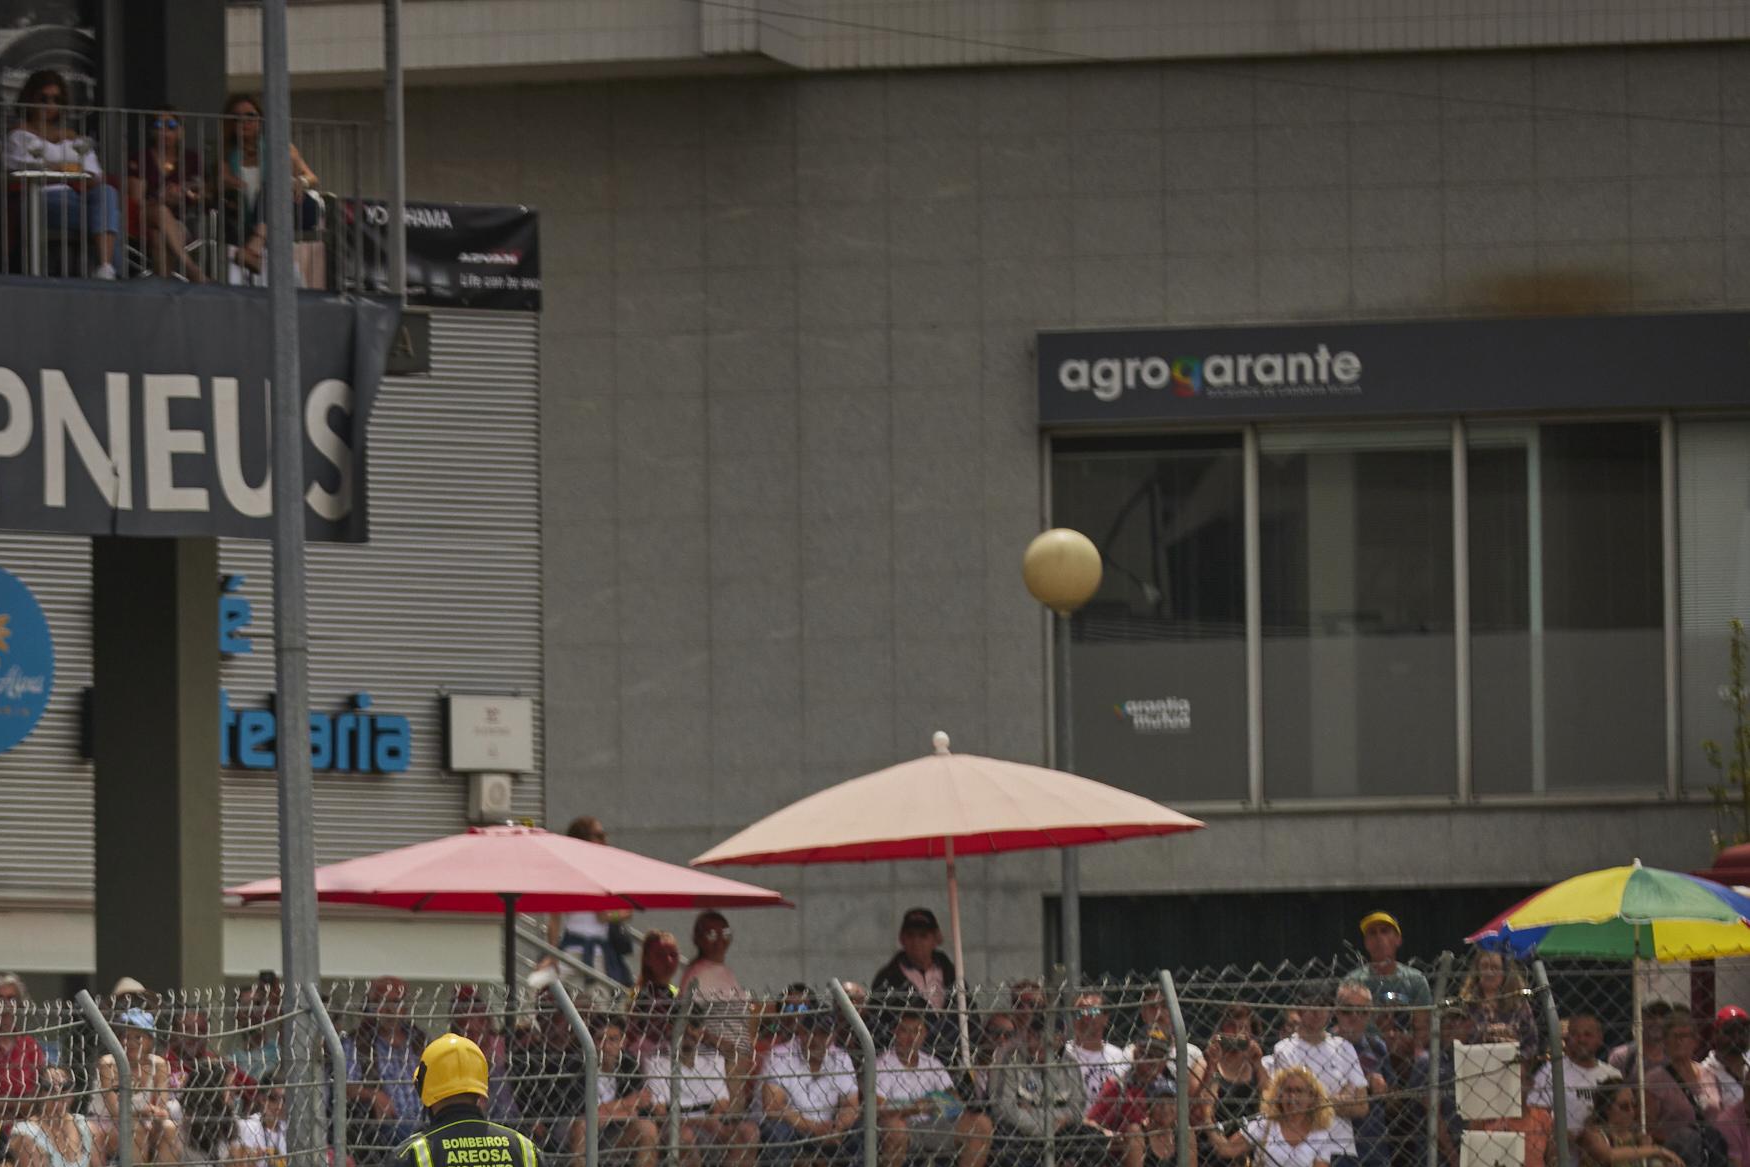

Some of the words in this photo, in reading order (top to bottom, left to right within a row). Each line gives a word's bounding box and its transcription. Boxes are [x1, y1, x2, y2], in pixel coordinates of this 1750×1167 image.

[363, 205, 454, 229] YOHAMA
[442, 1136, 510, 1149] BOMBEIROS
[447, 1148, 512, 1164] AREOSA
